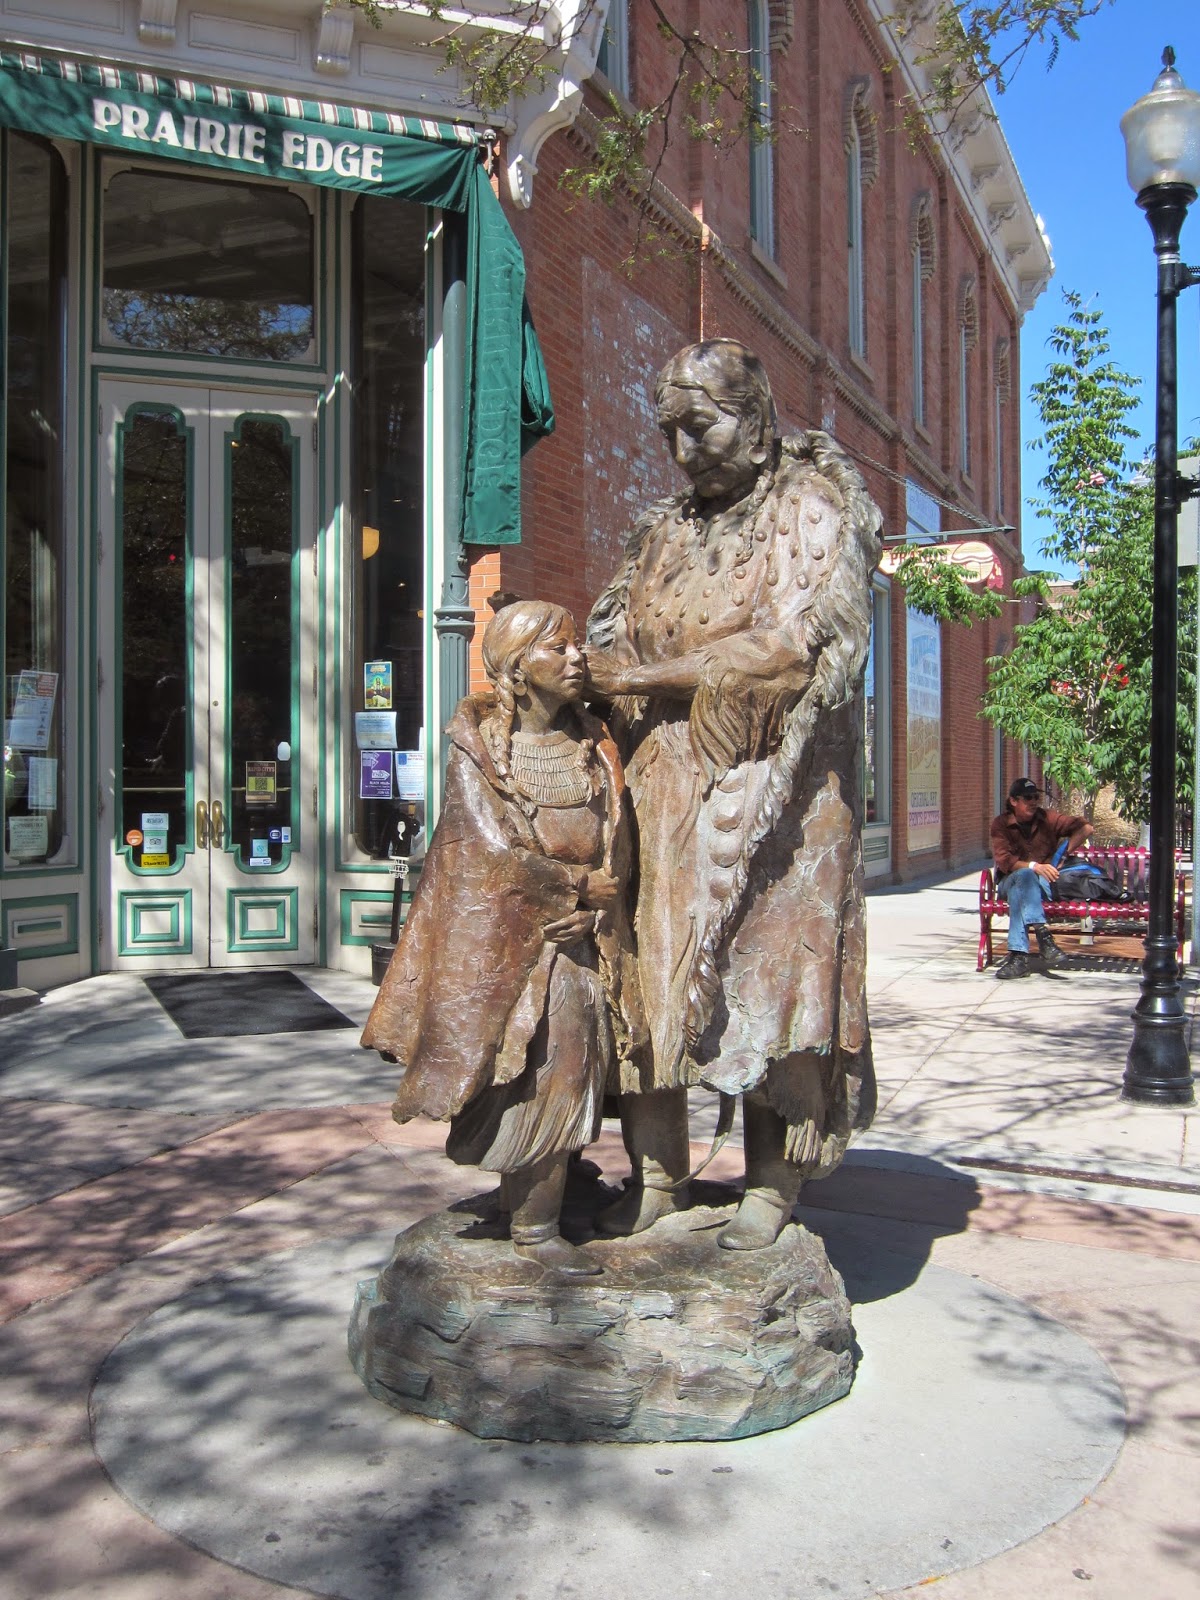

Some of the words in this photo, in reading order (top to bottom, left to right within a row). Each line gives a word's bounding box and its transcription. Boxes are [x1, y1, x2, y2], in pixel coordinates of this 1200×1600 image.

[92, 98, 267, 165] PRAIRIE
[281, 130, 384, 183] EDGE
[482, 210, 514, 376] PRAIRIE
[474, 387, 509, 488] EDGE
